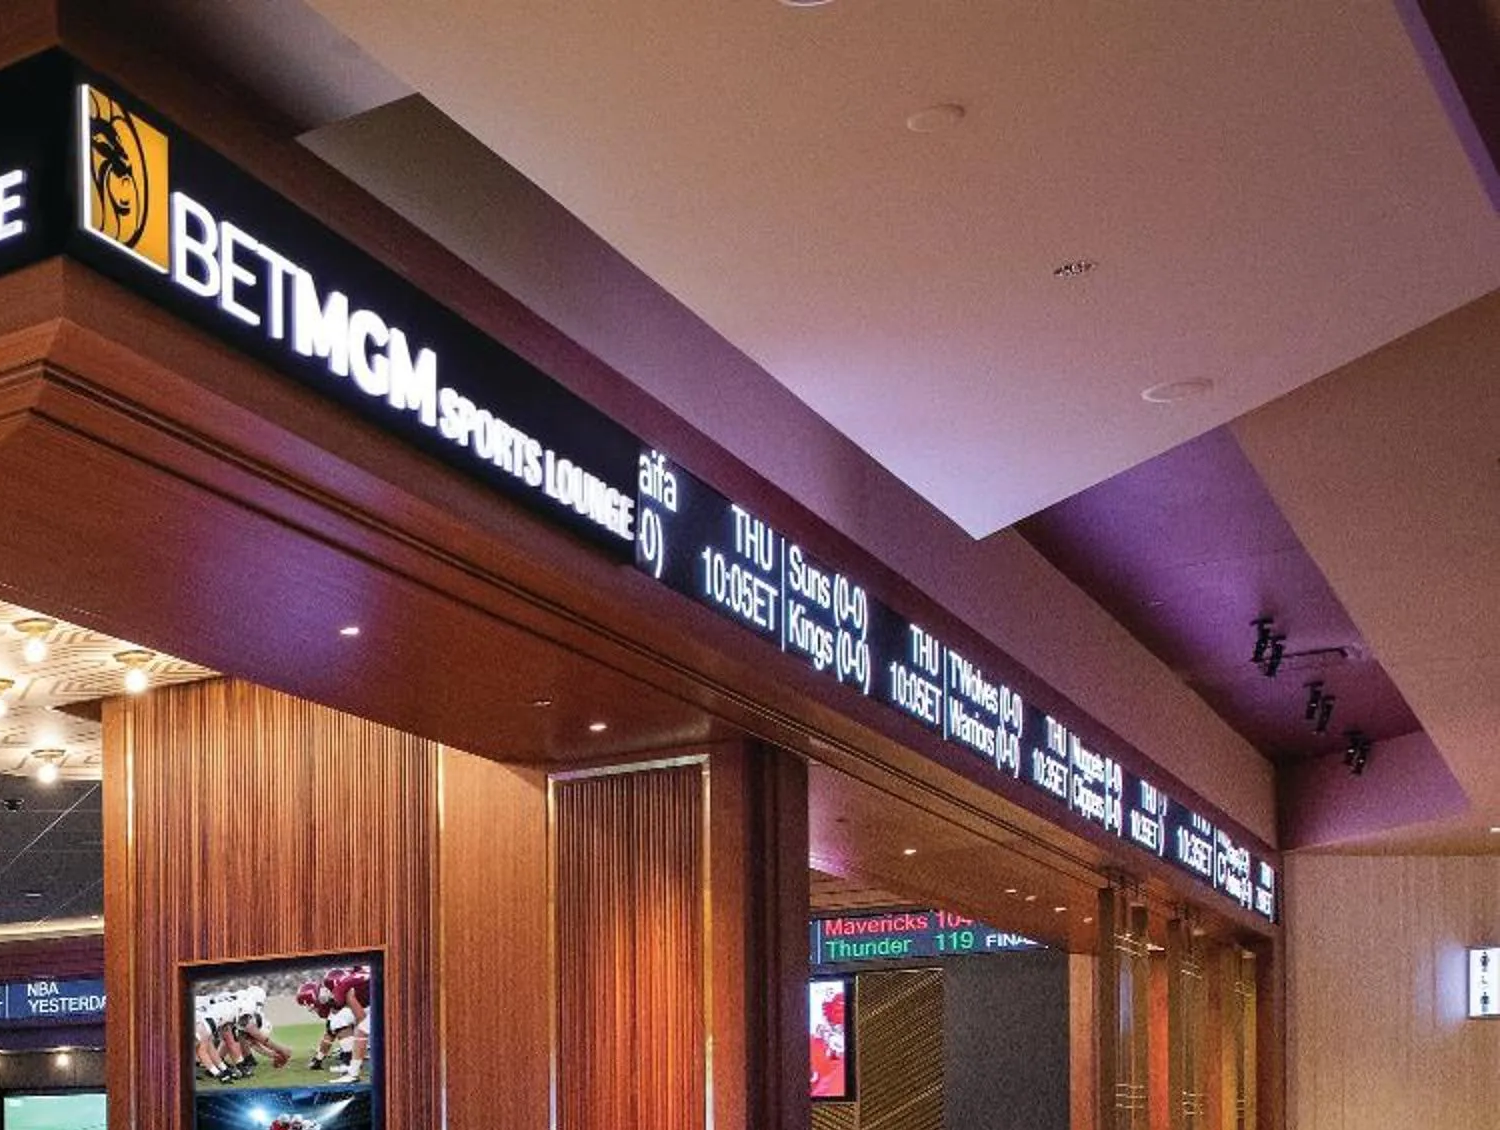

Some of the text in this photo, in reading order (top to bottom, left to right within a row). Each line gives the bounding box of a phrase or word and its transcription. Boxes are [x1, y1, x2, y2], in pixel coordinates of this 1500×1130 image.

[170, 191, 635, 542] BETMGM SPORTS LOUNGE
[731, 503, 773, 571] THU
[702, 546, 779, 632] 10:05ET
[788, 544, 869, 641] Suns (0-0)
[788, 600, 870, 695] Kings (0-0)
[908, 623, 940, 675] THU
[825, 913, 929, 937] Mavericks
[825, 931, 1039, 960] Thunder 119 FIN
[27, 981, 60, 998] NBA
